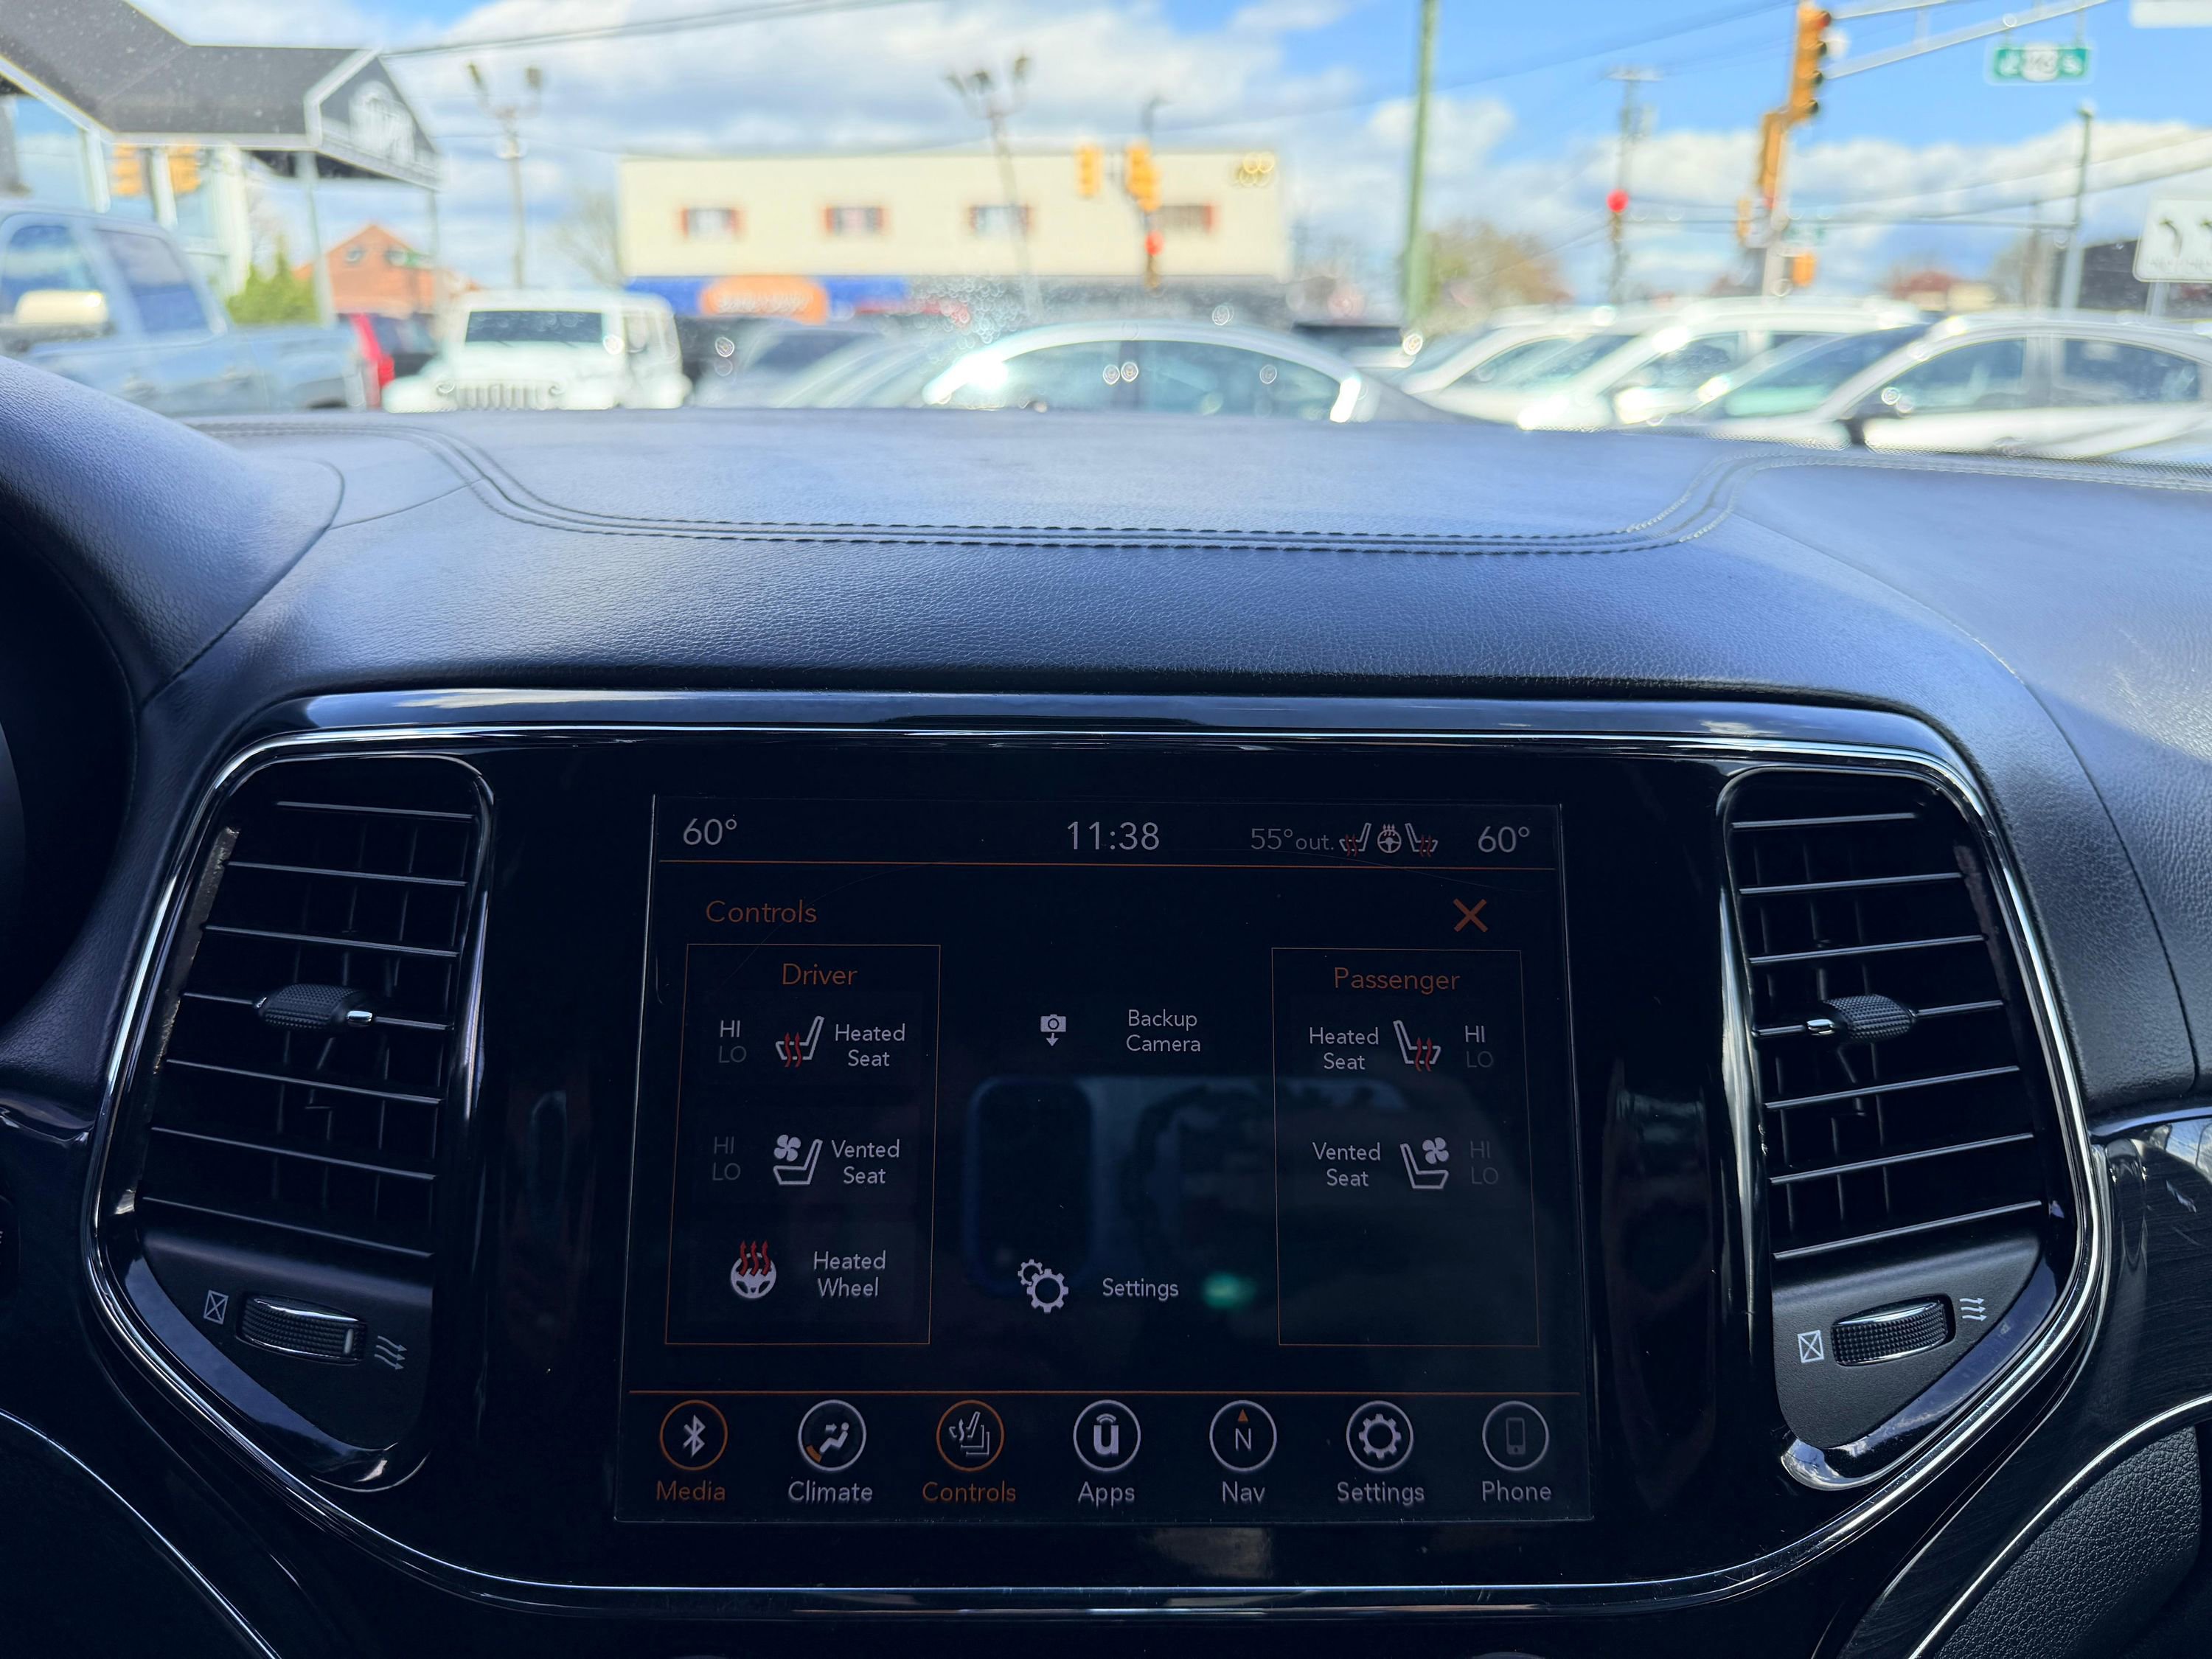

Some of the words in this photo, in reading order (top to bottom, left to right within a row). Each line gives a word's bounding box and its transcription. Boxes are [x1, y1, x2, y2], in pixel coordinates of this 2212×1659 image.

[683, 817, 737, 846] 60°
[1067, 821, 1160, 851] 11:38
[1478, 826, 1530, 853] 60°
[706, 899, 817, 923] Controls
[782, 963, 858, 985] Driver
[1335, 967, 1461, 995] Passenger
[720, 1020, 741, 1037] HI
[1128, 1009, 1197, 1032] Backup
[835, 1023, 905, 1042] Heated
[1310, 1026, 1379, 1045] Heated
[1464, 1025, 1485, 1043] HI
[1126, 1034, 1201, 1052] Camera
[718, 1045, 747, 1064] LO
[848, 1048, 890, 1067] Seat
[1324, 1051, 1366, 1070] Seat
[1466, 1050, 1494, 1068] LO
[713, 1136, 734, 1155] HI
[831, 1138, 900, 1158] Vented
[1312, 1141, 1381, 1161] Vented
[1470, 1141, 1491, 1158] HI
[712, 1162, 741, 1181] LO
[843, 1166, 886, 1184] Seat
[1326, 1168, 1369, 1187] Seat
[1471, 1166, 1499, 1185] LO
[813, 1250, 886, 1270] Heated
[817, 1276, 879, 1297] Wheel
[1102, 1277, 1179, 1301] Settings
[1235, 1427, 1252, 1450] N
[656, 1479, 726, 1501] Media
[787, 1480, 873, 1502] Climate
[922, 1481, 1016, 1502] Controls
[1077, 1481, 1135, 1507] Apps
[1222, 1481, 1265, 1503] Nav
[1337, 1481, 1425, 1506] Settings
[1482, 1479, 1552, 1501] Phone
